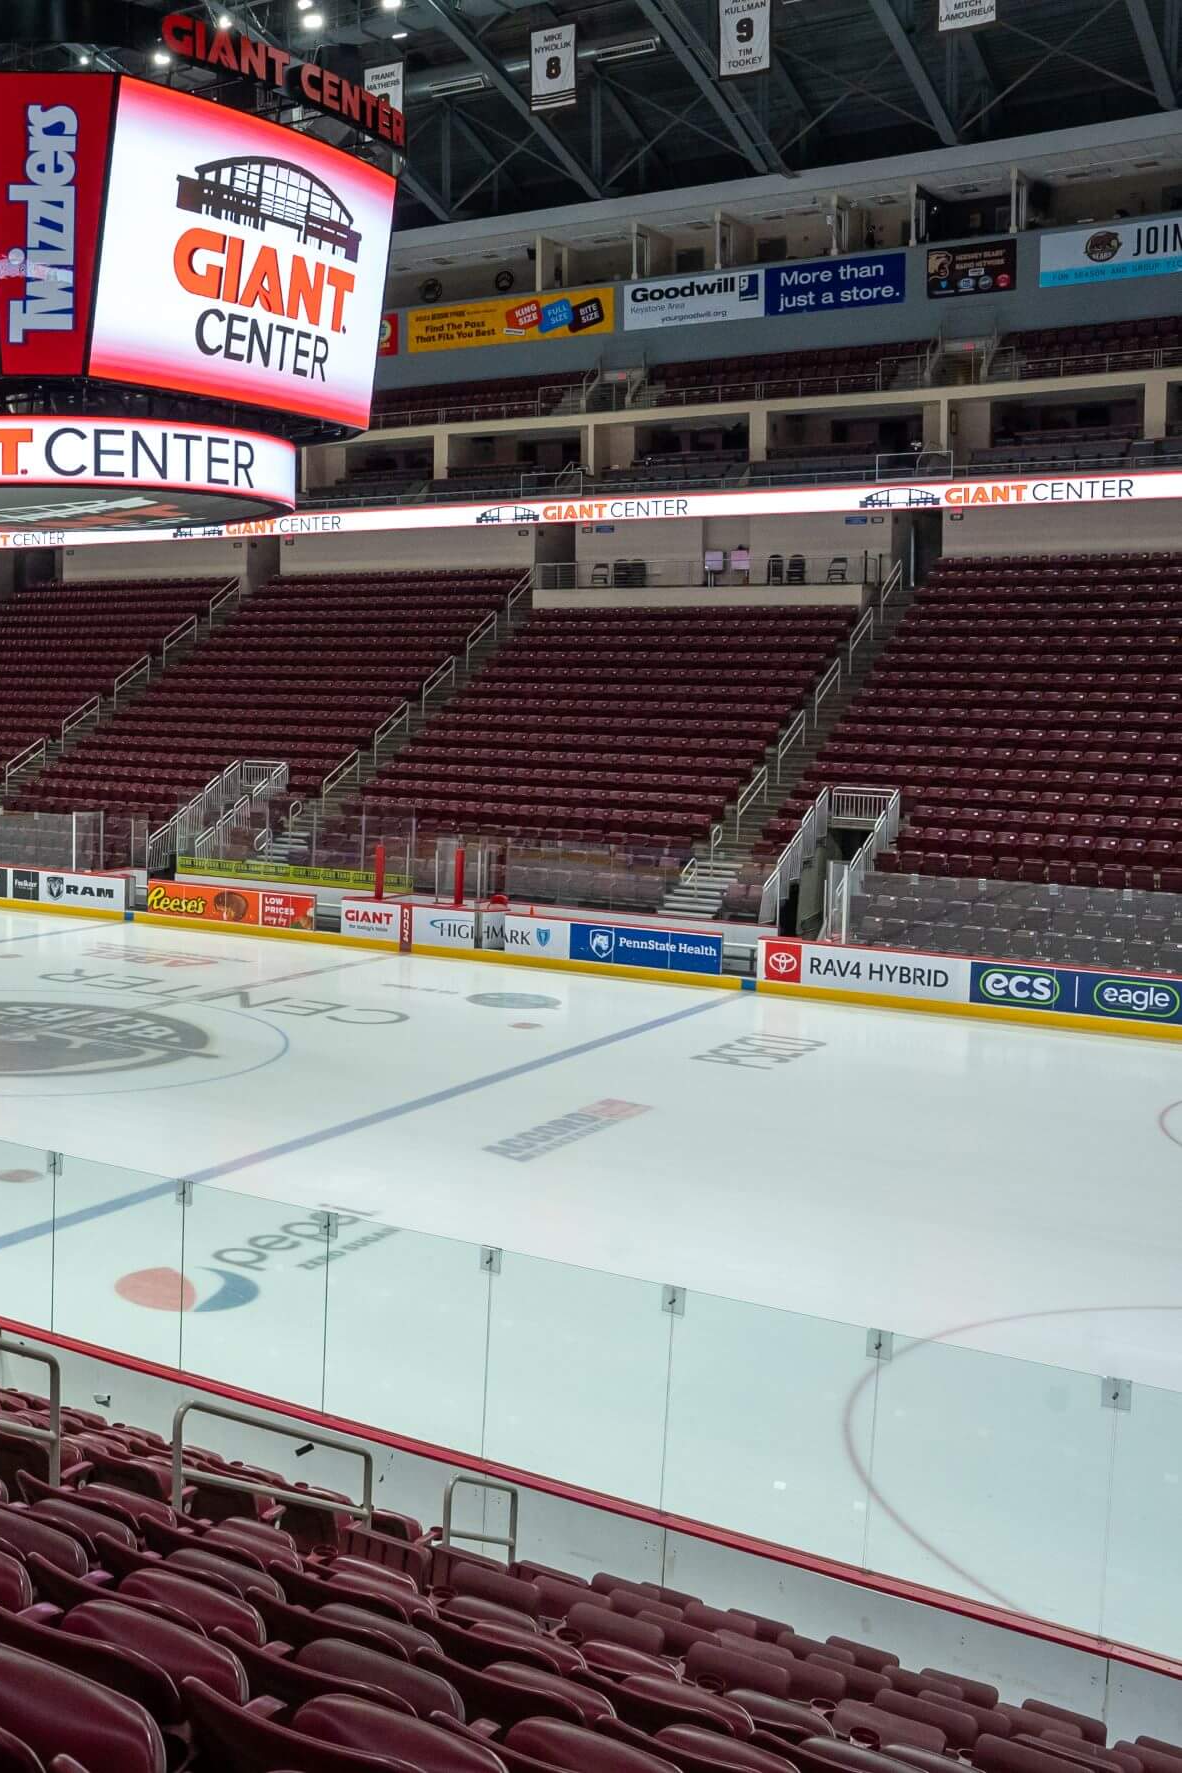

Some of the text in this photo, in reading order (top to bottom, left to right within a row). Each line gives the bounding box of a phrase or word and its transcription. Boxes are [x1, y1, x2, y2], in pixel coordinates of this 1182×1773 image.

[724, 1, 767, 16] KULLMAN
[543, 32, 563, 42] MIKE
[736, 17, 754, 43] 9
[738, 48, 753, 56] TIM
[546, 56, 561, 80] 8
[728, 56, 763, 69] TOOKEY
[162, 14, 406, 145] GIANT CENTER
[371, 71, 395, 82] FRANK
[9, 105, 78, 343] Twizzlers
[173, 227, 355, 334] GIANT
[780, 262, 884, 287] More than
[631, 276, 736, 303] Goodwill
[778, 284, 901, 312] just a store.
[515, 303, 538, 318] KING
[547, 304, 568, 318] FULL
[579, 303, 598, 316] BITE
[630, 301, 685, 315] Keystone Area
[518, 313, 539, 326] SIZE
[550, 312, 569, 325] SIZE
[581, 310, 600, 323] SIZE
[425, 320, 486, 334] Find The Pass
[415, 334, 436, 344] That
[438, 333, 454, 341] Fits
[457, 330, 473, 339] You
[475, 328, 496, 337] Best
[195, 308, 329, 383] CENTER
[45, 427, 255, 488] CENTER
[945, 479, 1134, 504] GIANT CENTER
[542, 499, 688, 520] GIANT CENTER
[226, 515, 341, 536] GIANT CENTER
[13, 532, 66, 546] CENTER
[65, 884, 115, 899] RAM
[148, 887, 205, 914] Reese's
[264, 897, 283, 905] LOW
[264, 906, 295, 916] PRICES
[345, 909, 393, 925] GIANT
[619, 937, 718, 957] PennState Health
[809, 956, 949, 988] RAV4 HYBRID
[985, 973, 1051, 1001] ecs
[1103, 986, 1170, 1012] eagle
